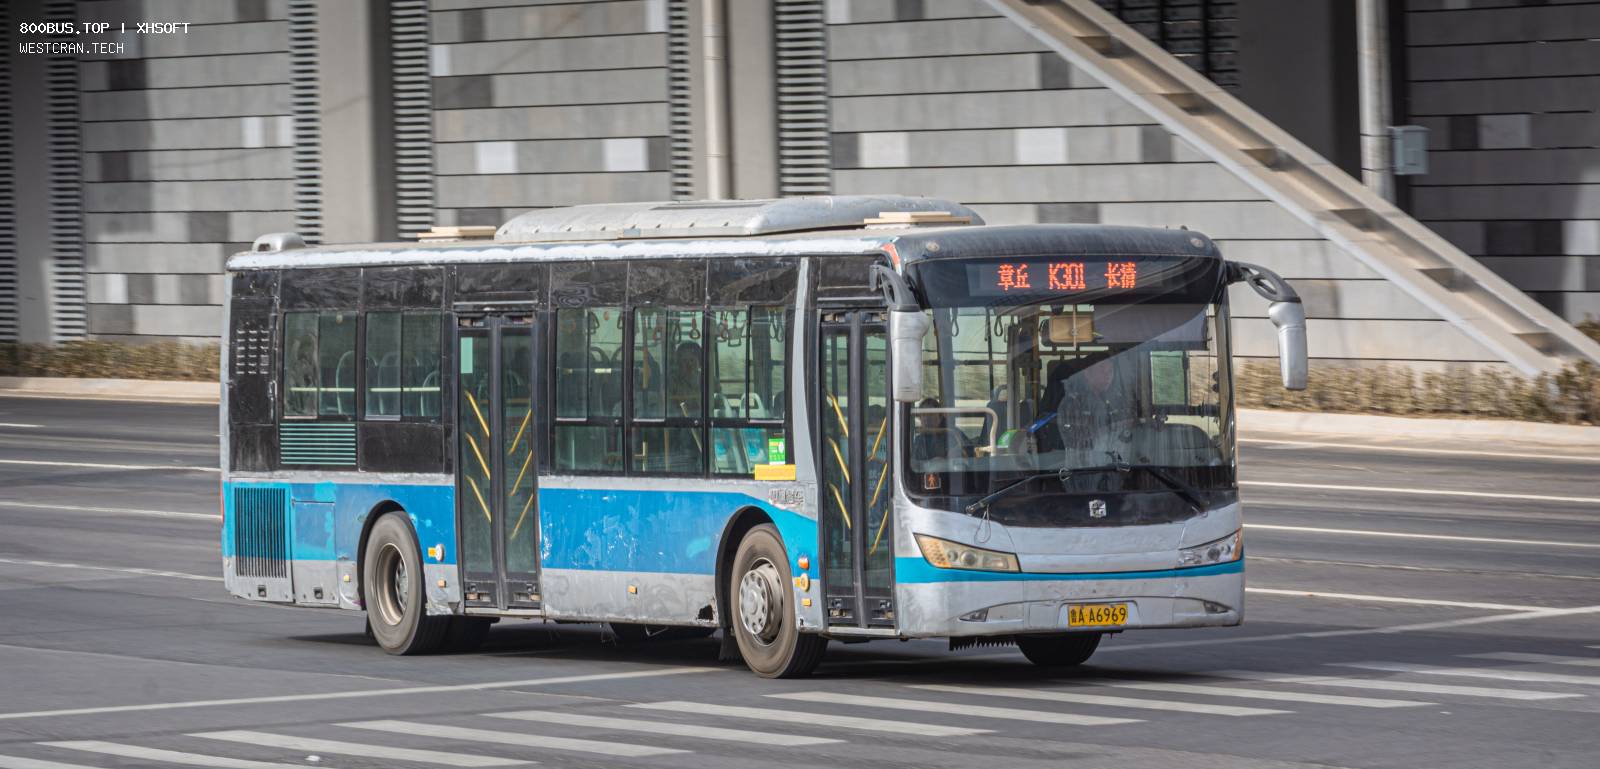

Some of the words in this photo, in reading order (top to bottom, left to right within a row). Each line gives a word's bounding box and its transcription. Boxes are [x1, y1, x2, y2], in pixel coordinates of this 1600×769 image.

[997, 263, 1032, 291] 章丘
[1048, 262, 1087, 290] K301
[1104, 261, 1138, 289] 长清
